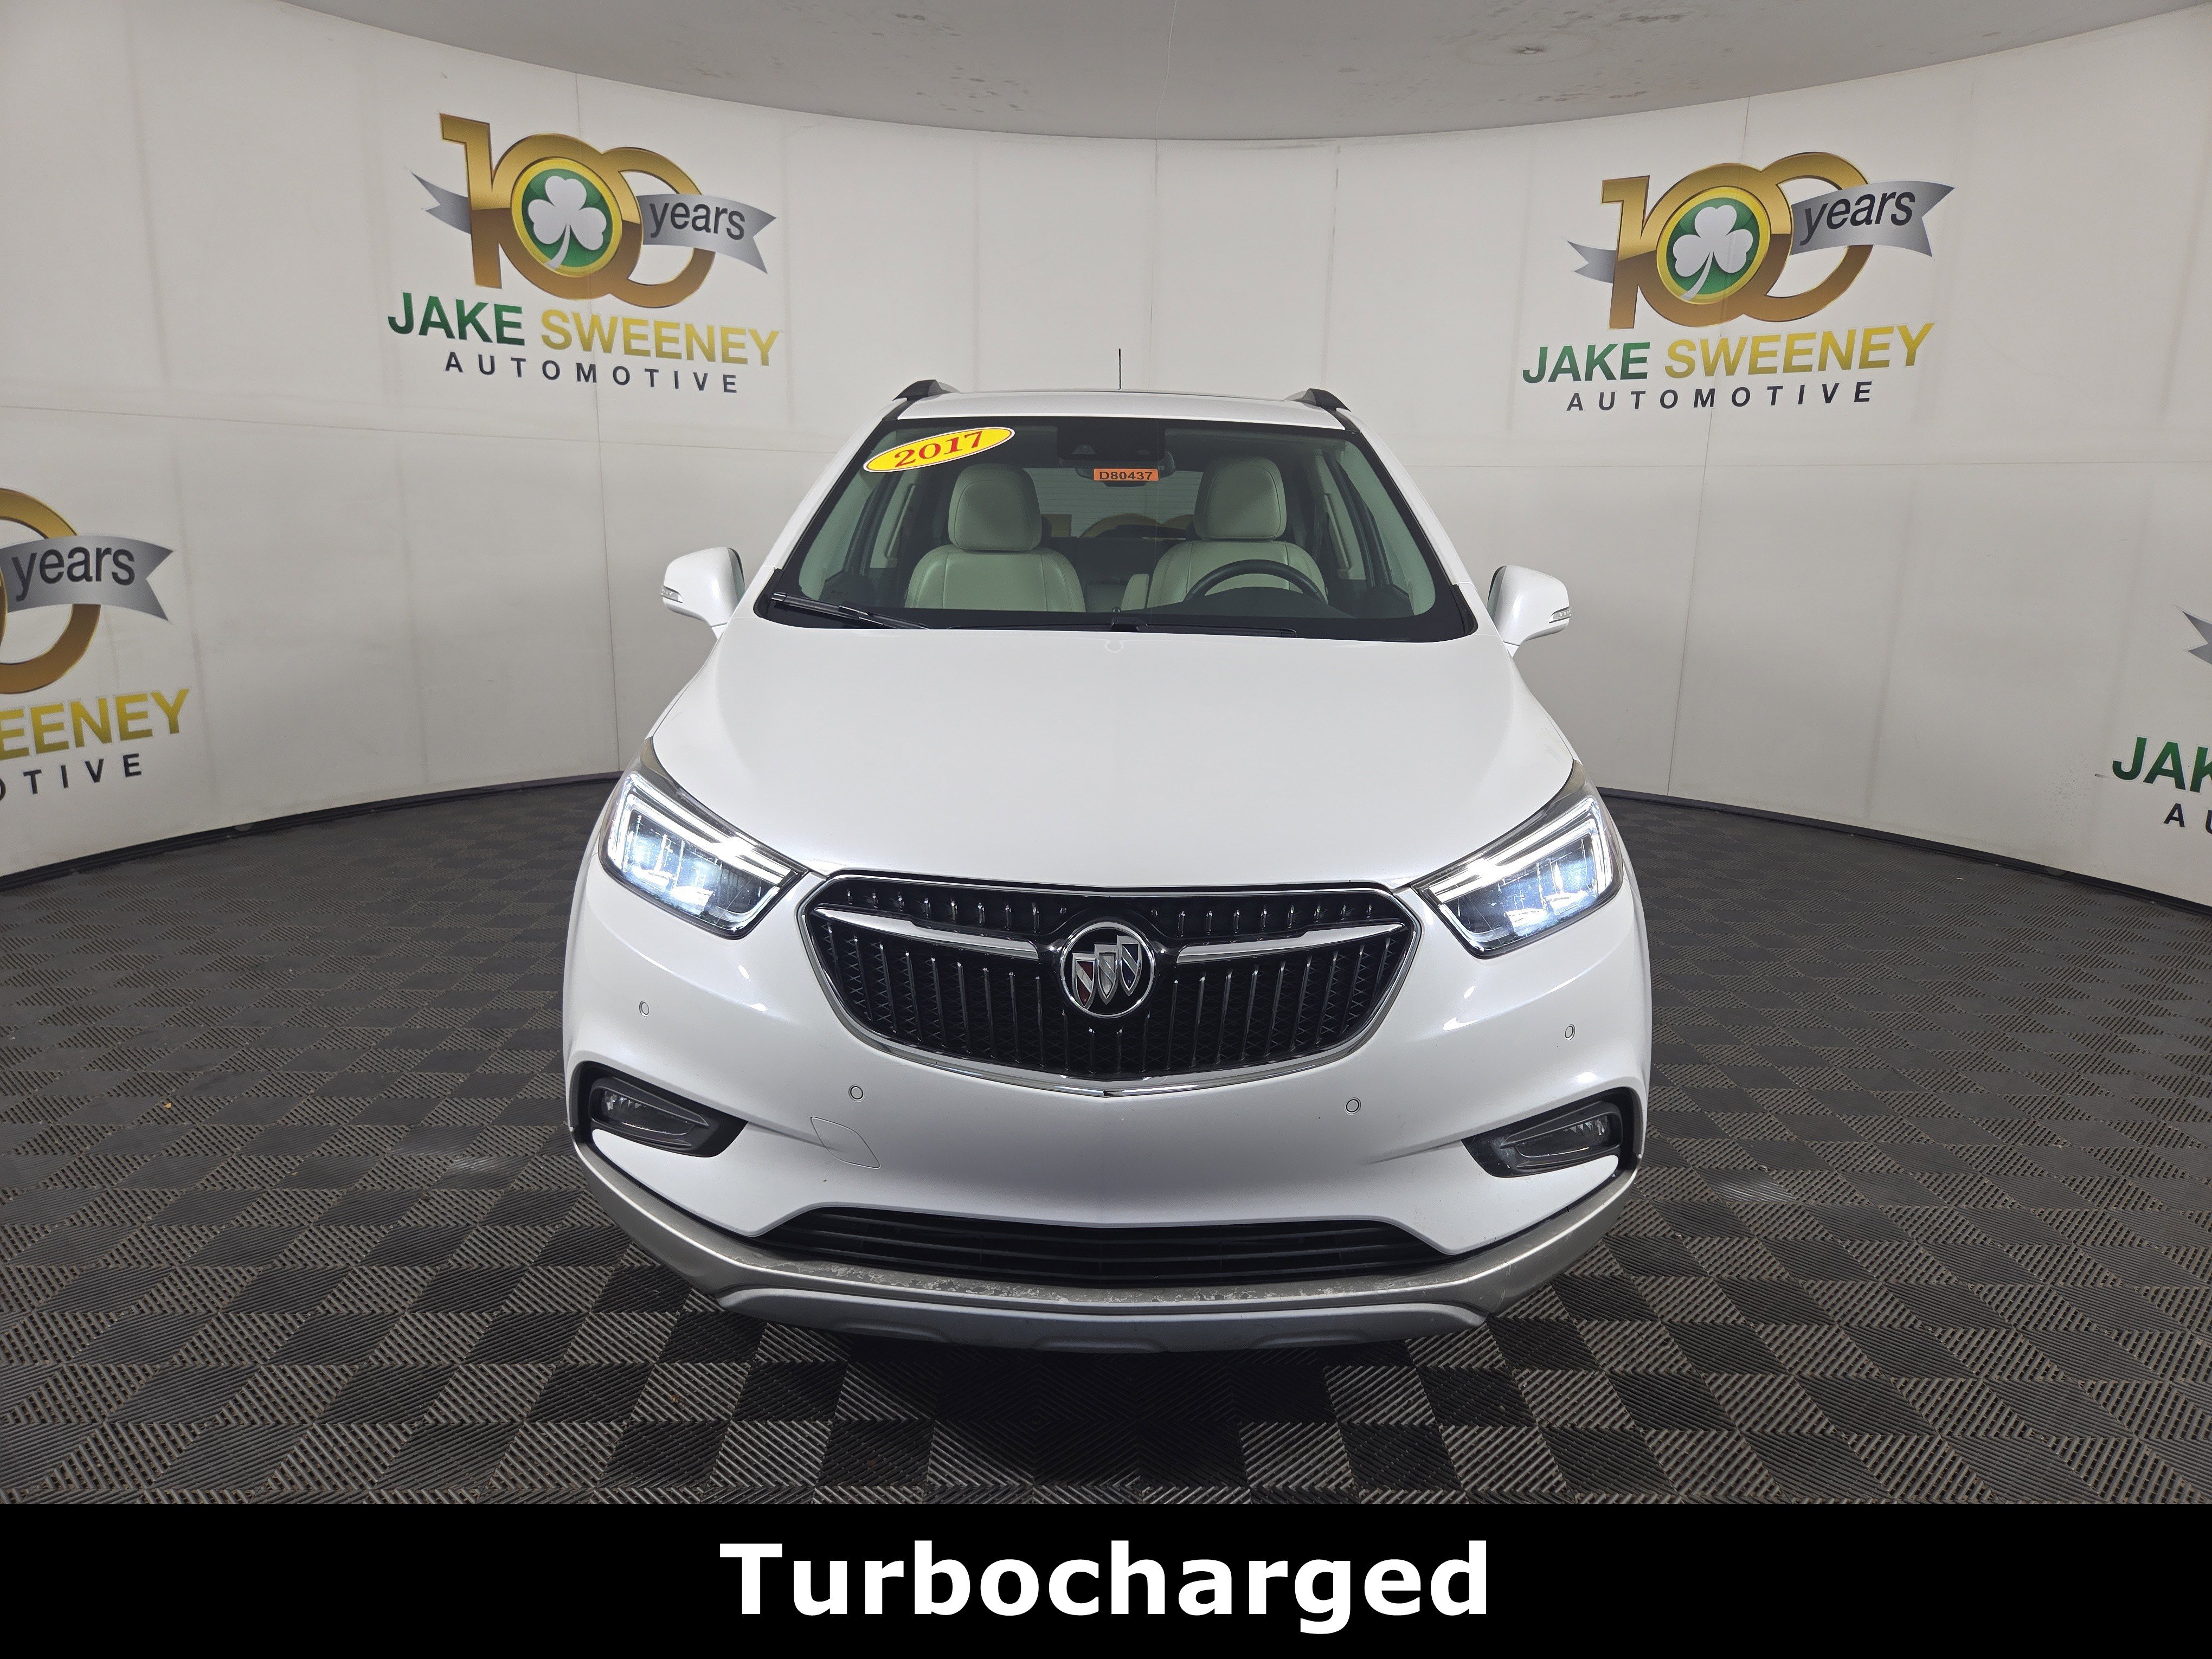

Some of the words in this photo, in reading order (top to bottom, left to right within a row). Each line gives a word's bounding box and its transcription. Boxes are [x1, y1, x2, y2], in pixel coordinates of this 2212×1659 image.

[439, 113, 716, 308] 100
[650, 201, 745, 240] years
[1600, 151, 1875, 330] 100
[1798, 190, 1915, 246] years
[388, 292, 525, 346] JAKE
[541, 309, 780, 367] SWEENEY
[1522, 342, 1650, 383] JAKE
[1664, 322, 1935, 379] SWEENEY
[445, 351, 737, 394] AUTOMOTIVE
[1566, 381, 1872, 411] AUTOMOTIVE
[895, 431, 983, 468] 2017
[1099, 472, 1153, 480] D80437
[11, 546, 136, 601] years
[0, 753, 142, 801] TIVE
